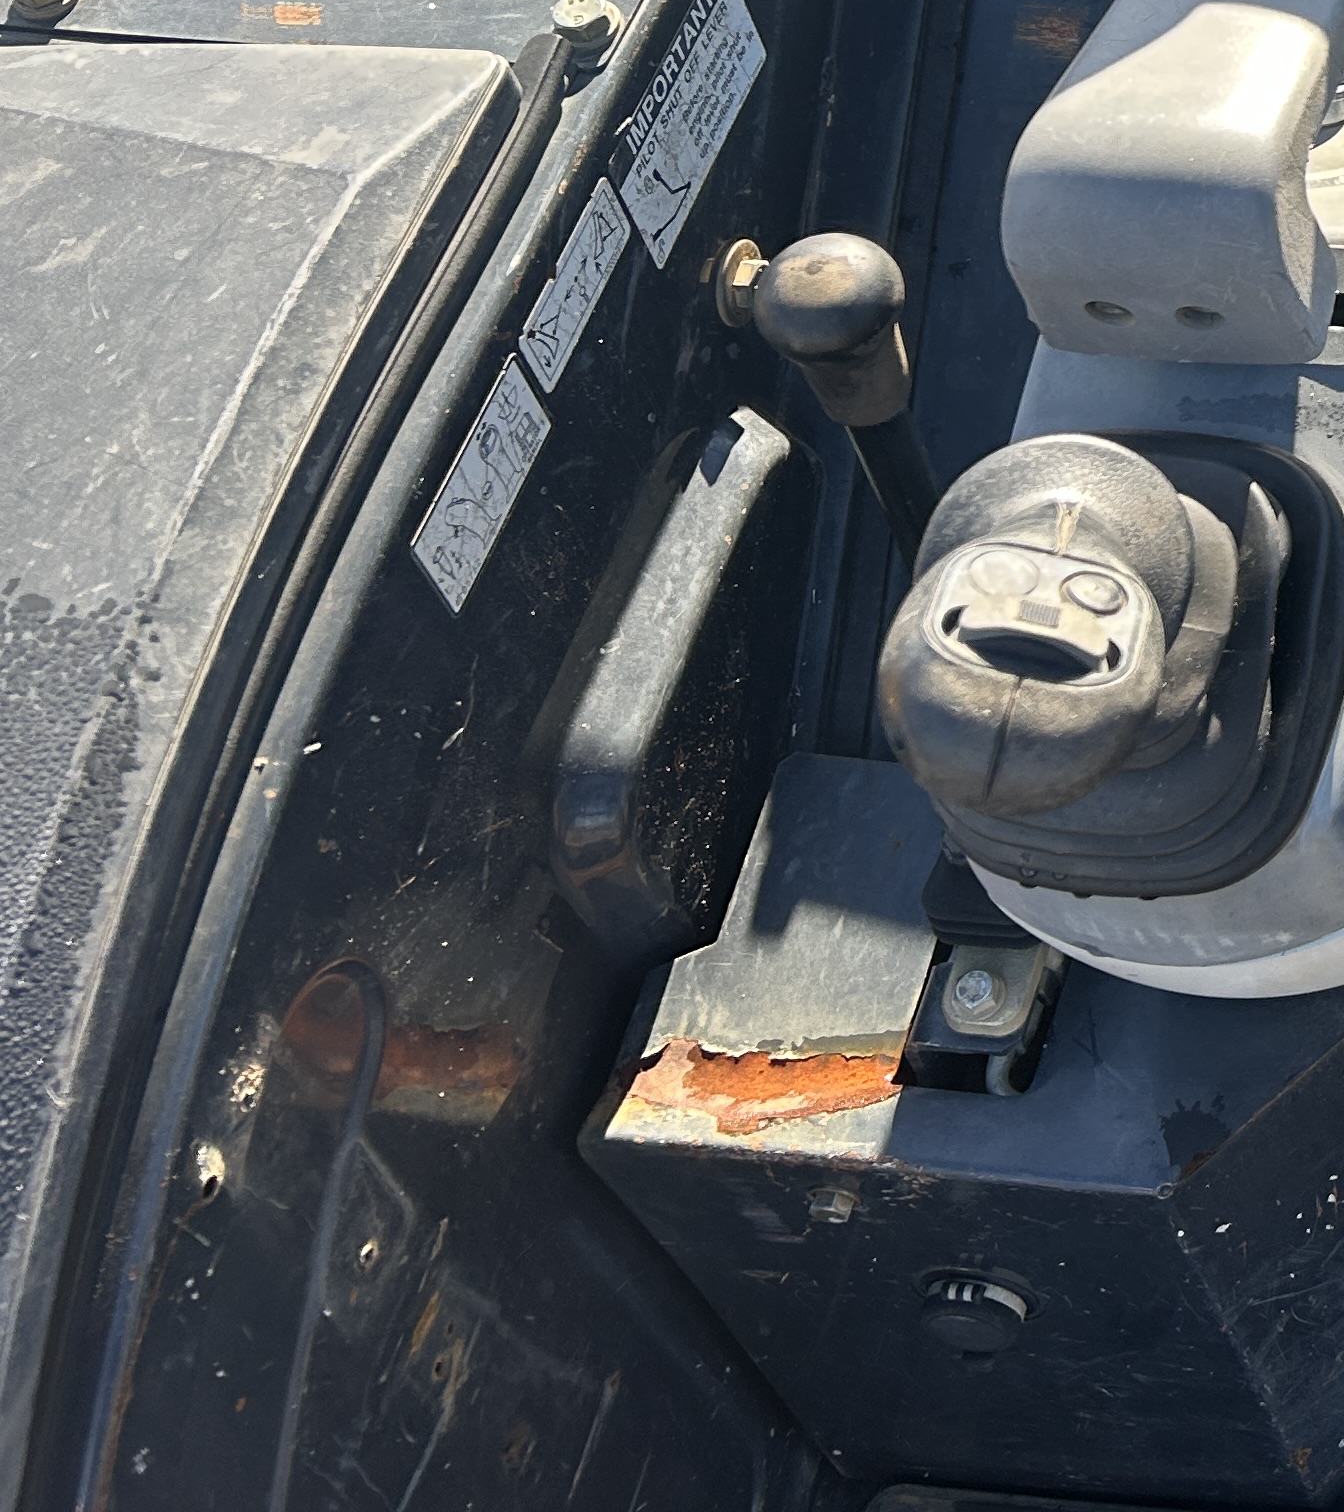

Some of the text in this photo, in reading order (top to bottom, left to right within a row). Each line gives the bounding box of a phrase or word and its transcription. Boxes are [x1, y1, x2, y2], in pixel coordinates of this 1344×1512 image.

[710, 59, 727, 91] pilot
[725, 29, 741, 61] shut
[719, 61, 737, 96] must
[736, 41, 746, 63] be
[634, 129, 661, 179] PILOT
[659, 83, 684, 131] SHUT
[682, 49, 701, 86] OFF
